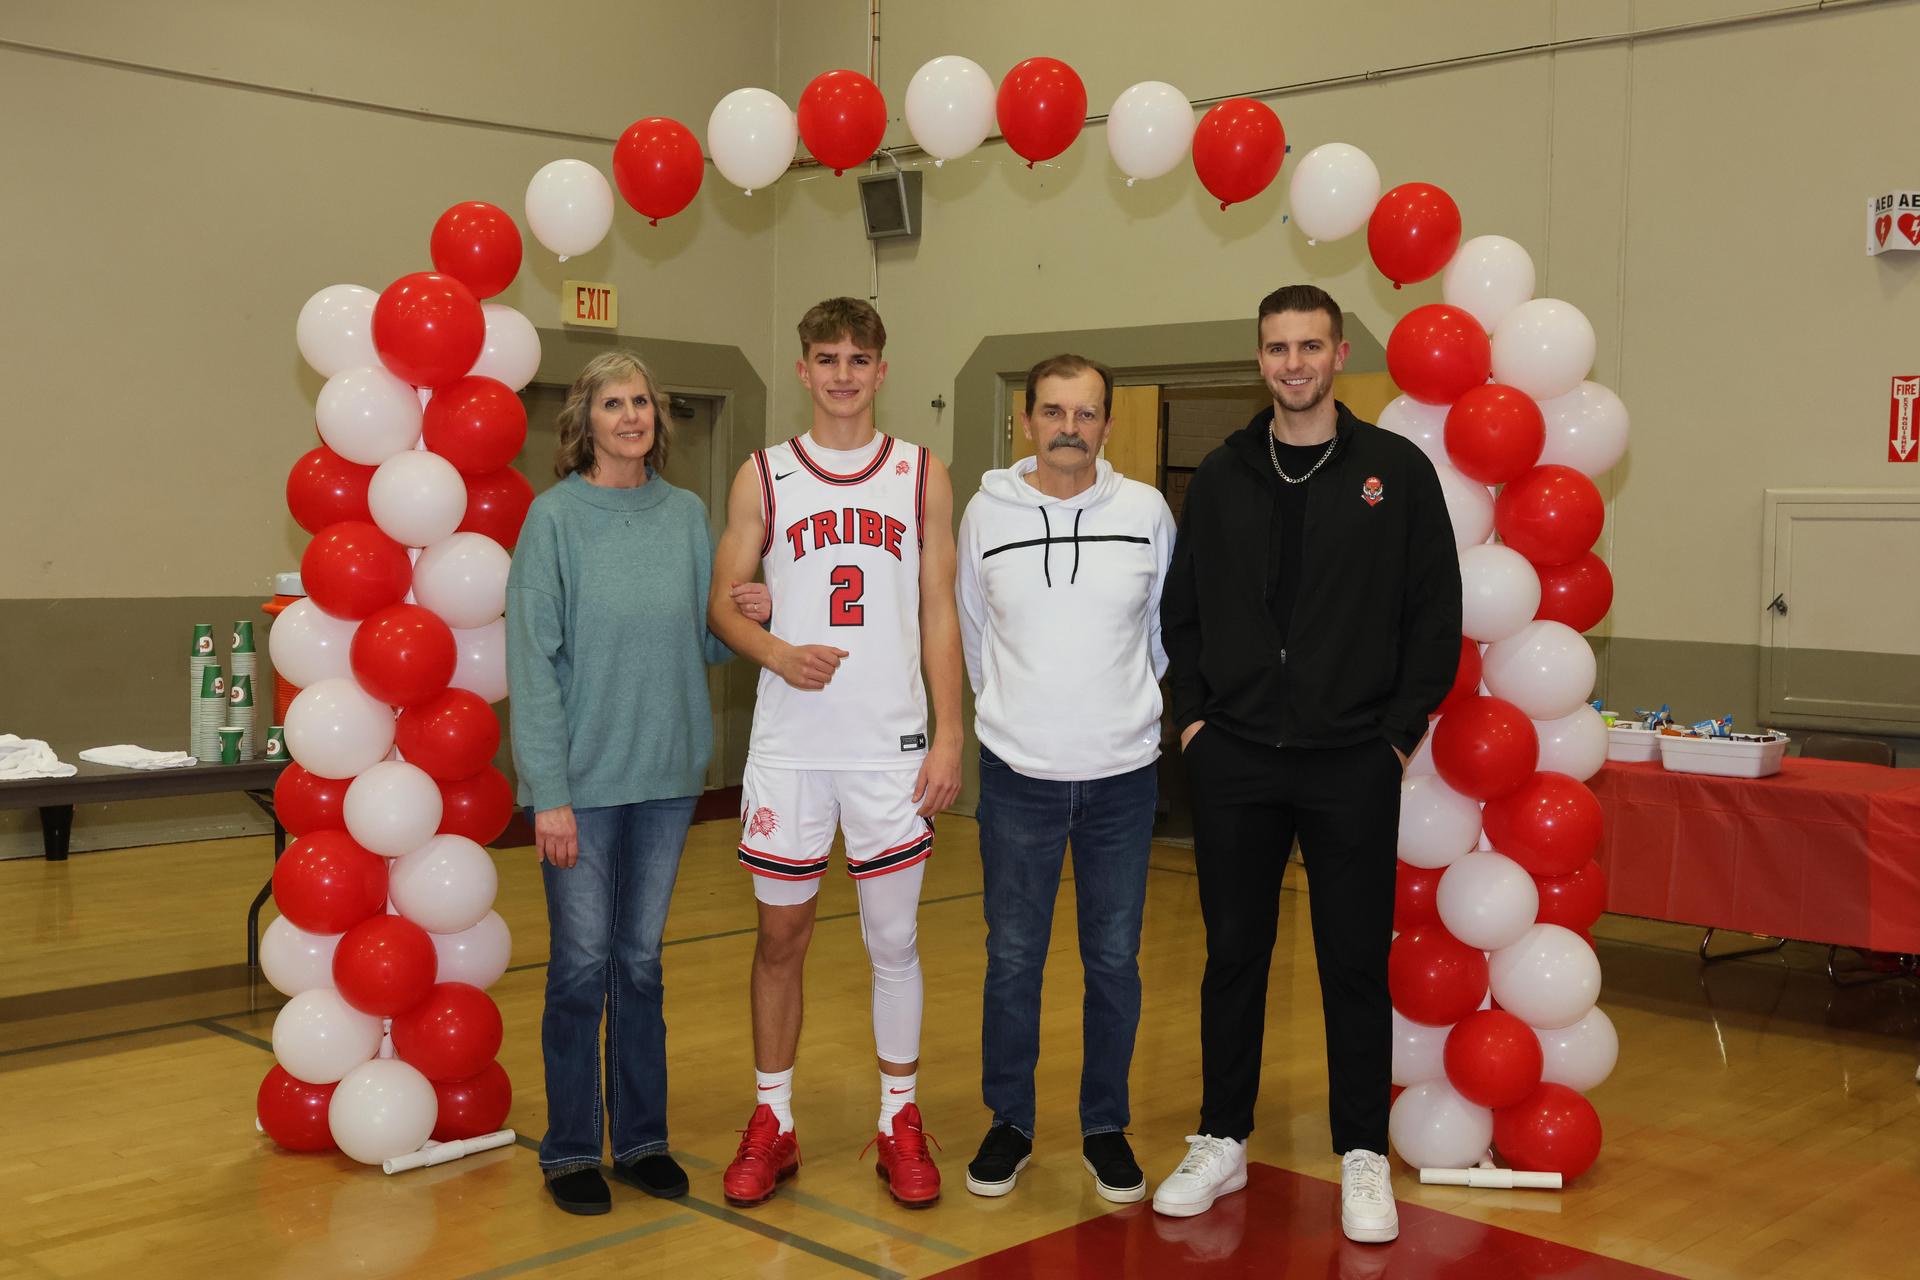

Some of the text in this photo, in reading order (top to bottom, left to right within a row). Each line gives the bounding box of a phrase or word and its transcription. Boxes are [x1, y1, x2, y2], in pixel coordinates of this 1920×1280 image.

[1875, 194, 1894, 212] AED
[576, 286, 611, 321] EXIT
[1896, 383, 1917, 396] FIRE
[786, 507, 907, 562] TRIBE
[829, 564, 865, 627] 2
